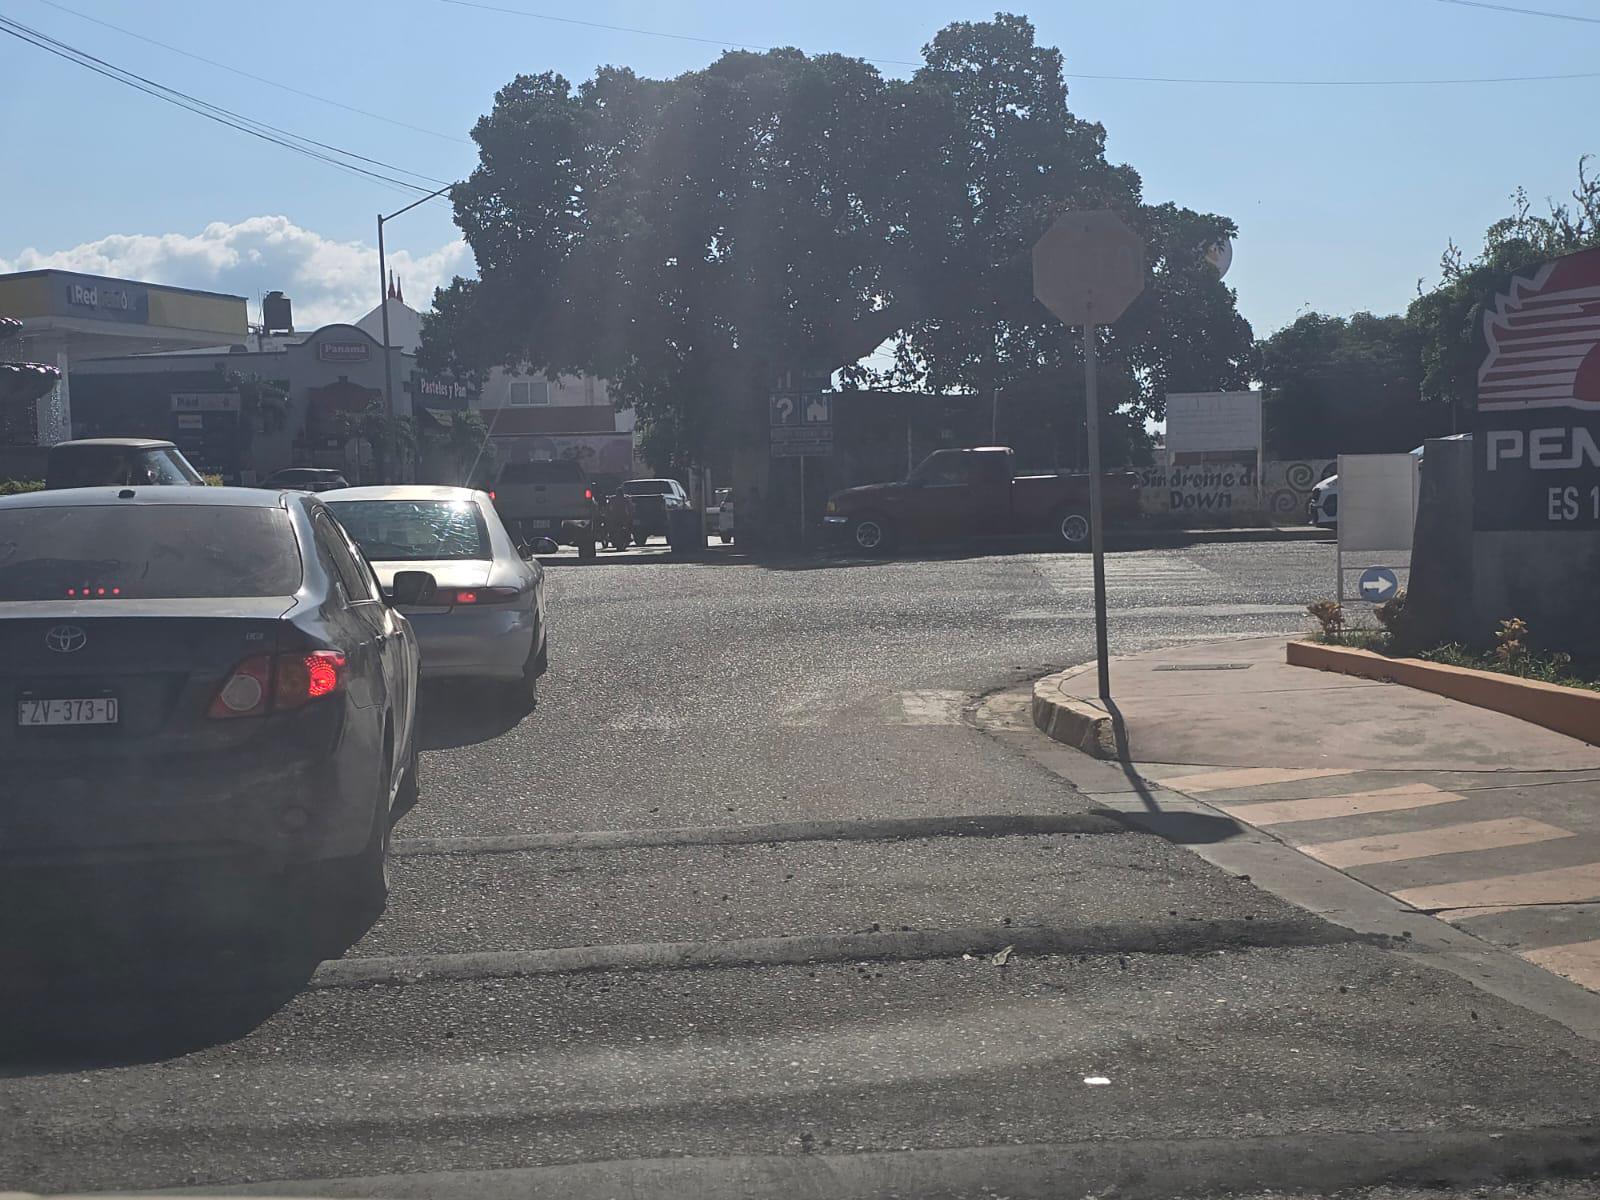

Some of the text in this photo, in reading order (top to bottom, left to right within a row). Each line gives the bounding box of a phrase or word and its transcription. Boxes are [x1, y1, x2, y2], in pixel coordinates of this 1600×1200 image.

[421, 379, 448, 397] Pasteles
[449, 384, 453, 399] y
[454, 382, 467, 398] Pan
[1548, 486, 1579, 521] ES
[20, 699, 116, 724] FZV-373-D
